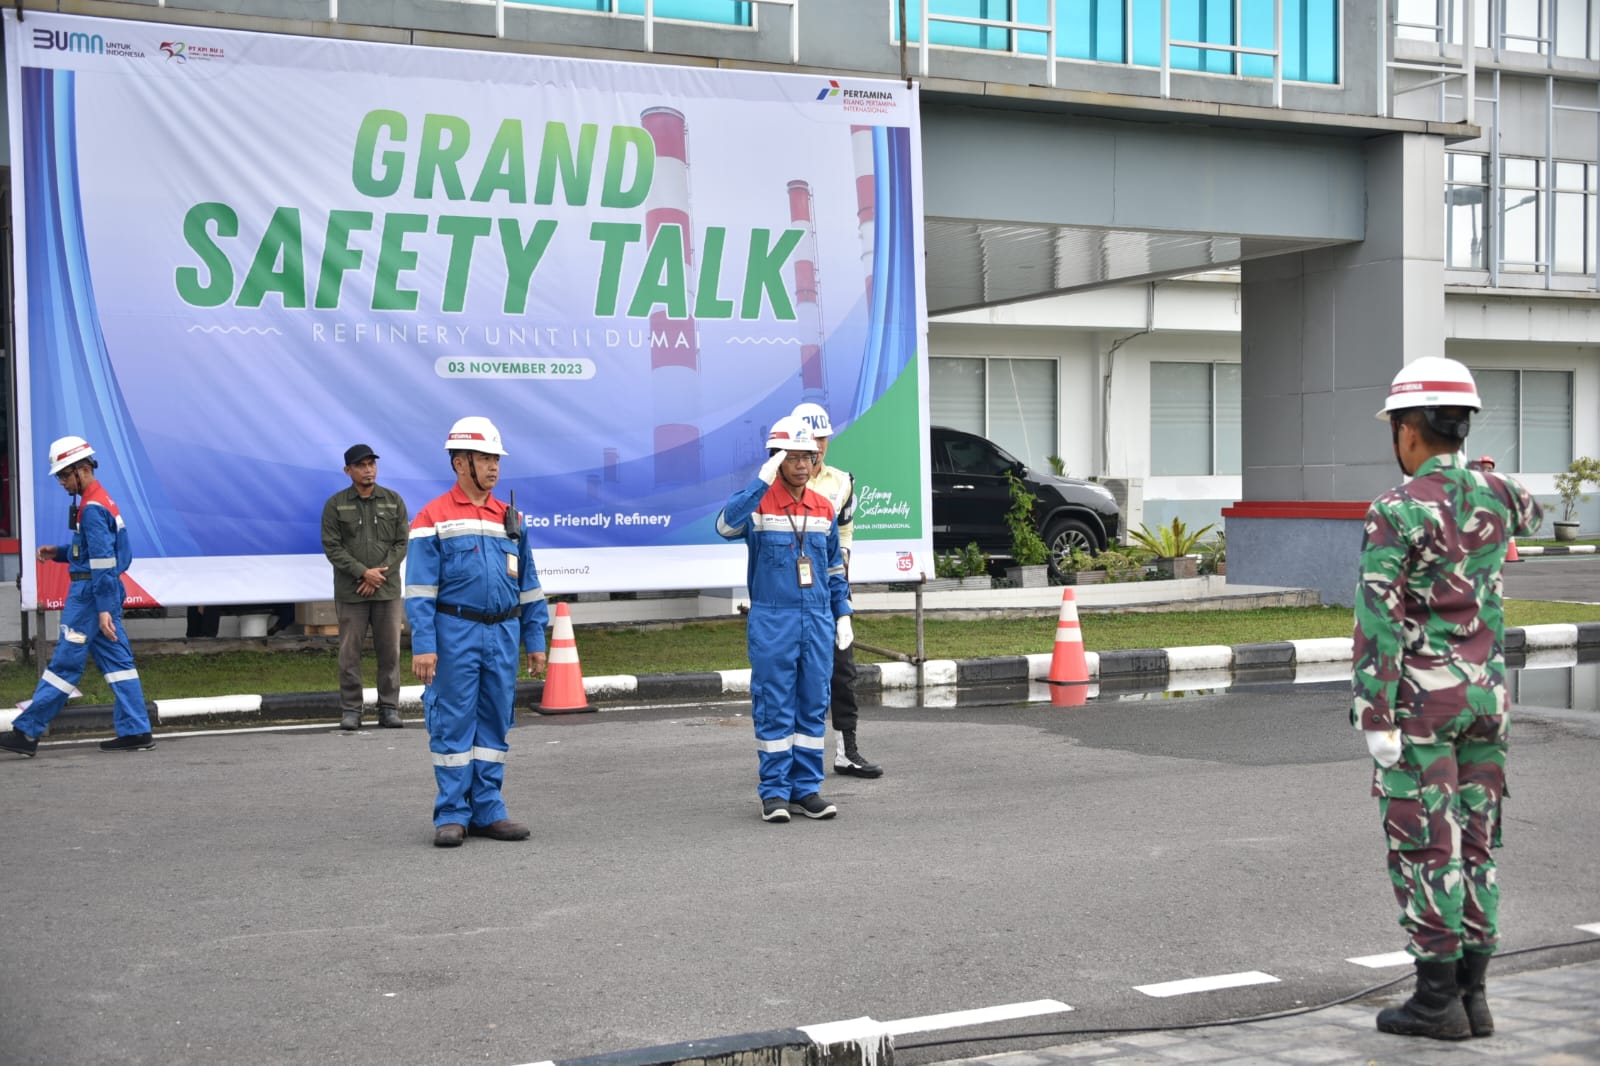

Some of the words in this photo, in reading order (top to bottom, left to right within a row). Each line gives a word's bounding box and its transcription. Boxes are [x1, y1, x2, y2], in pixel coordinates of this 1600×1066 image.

[105, 49, 146, 58] INDONESIA
[843, 90, 893, 100] PERTAMINA
[351, 108, 657, 210] GRAND
[174, 201, 559, 316] SAFETY
[589, 221, 807, 322] TALK
[312, 323, 469, 346] REFINERY
[485, 327, 559, 347] UNIT
[572, 329, 591, 347] II
[604, 331, 701, 350] DUMAI
[448, 361, 466, 374] 03
[469, 361, 548, 376] NOVEMBER
[550, 363, 584, 376] 2023
[525, 514, 550, 528] Eco
[553, 512, 611, 529] Friendly
[615, 512, 672, 528] Refinery
